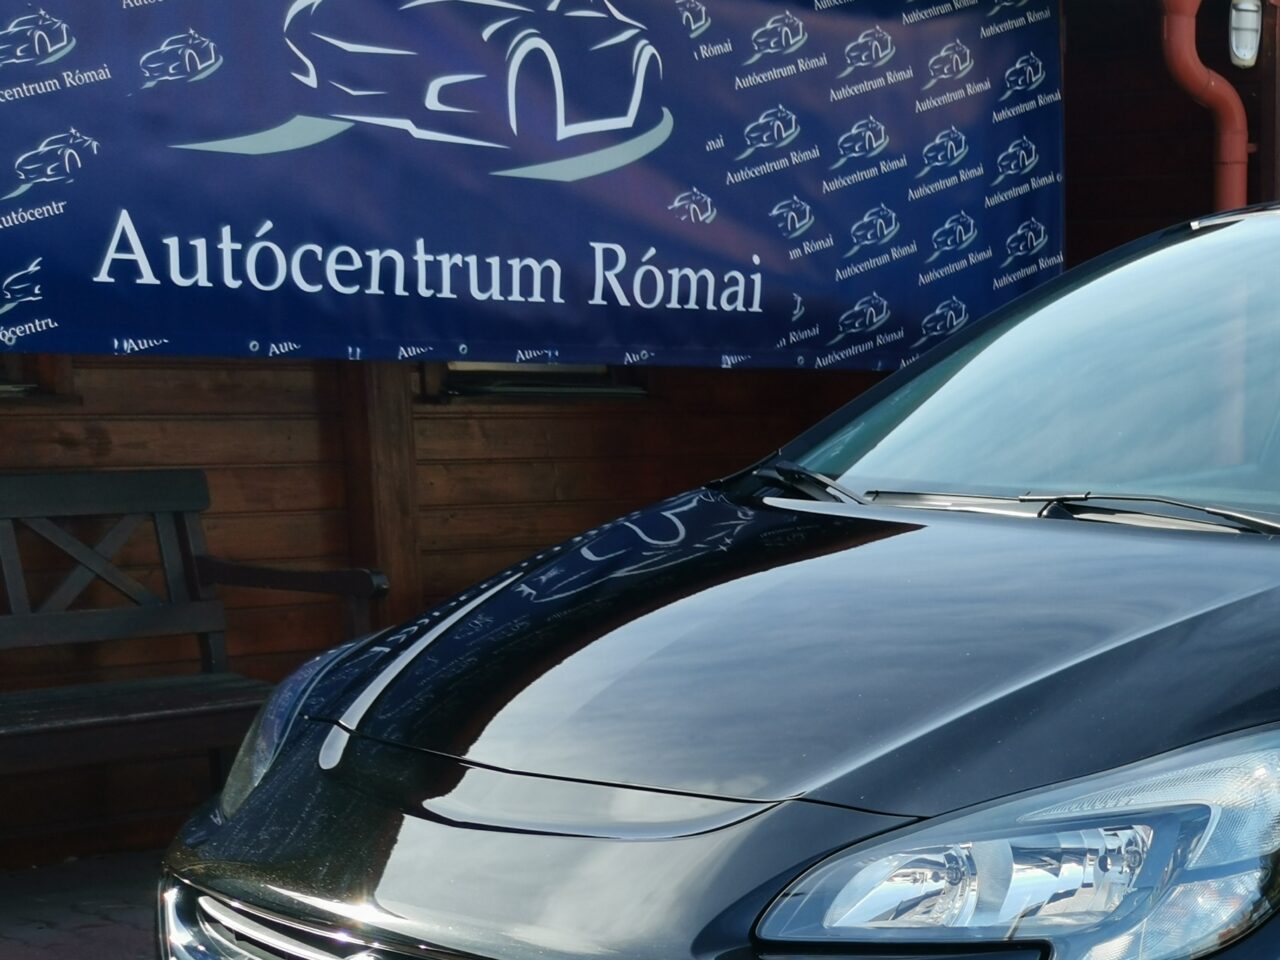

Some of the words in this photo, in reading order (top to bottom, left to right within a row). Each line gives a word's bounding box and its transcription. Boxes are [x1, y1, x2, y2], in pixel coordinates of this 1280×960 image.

[980, 15, 1026, 39] Autócentrum
[1026, 6, 1051, 25] Római
[701, 38, 733, 61] Római
[62, 63, 112, 88] Római
[735, 64, 797, 90] Autócentrum
[797, 53, 828, 73] Római
[830, 77, 886, 102] Autócentrum
[885, 65, 914, 85] Római
[915, 90, 965, 113] Autócentrum
[965, 77, 991, 96] Római
[726, 156, 789, 185] Autócentrum
[789, 145, 820, 165] Római
[822, 166, 879, 194] Autócentrum
[878, 153, 908, 175] Római
[907, 175, 960, 201] Autócentrum
[958, 162, 985, 183] Római
[93, 209, 566, 304] Autócentrum
[588, 240, 763, 313] Római
[802, 233, 834, 255] Római
[835, 254, 891, 282] Autócentrum
[890, 240, 918, 260] Római
[918, 260, 969, 287] Autócentrum
